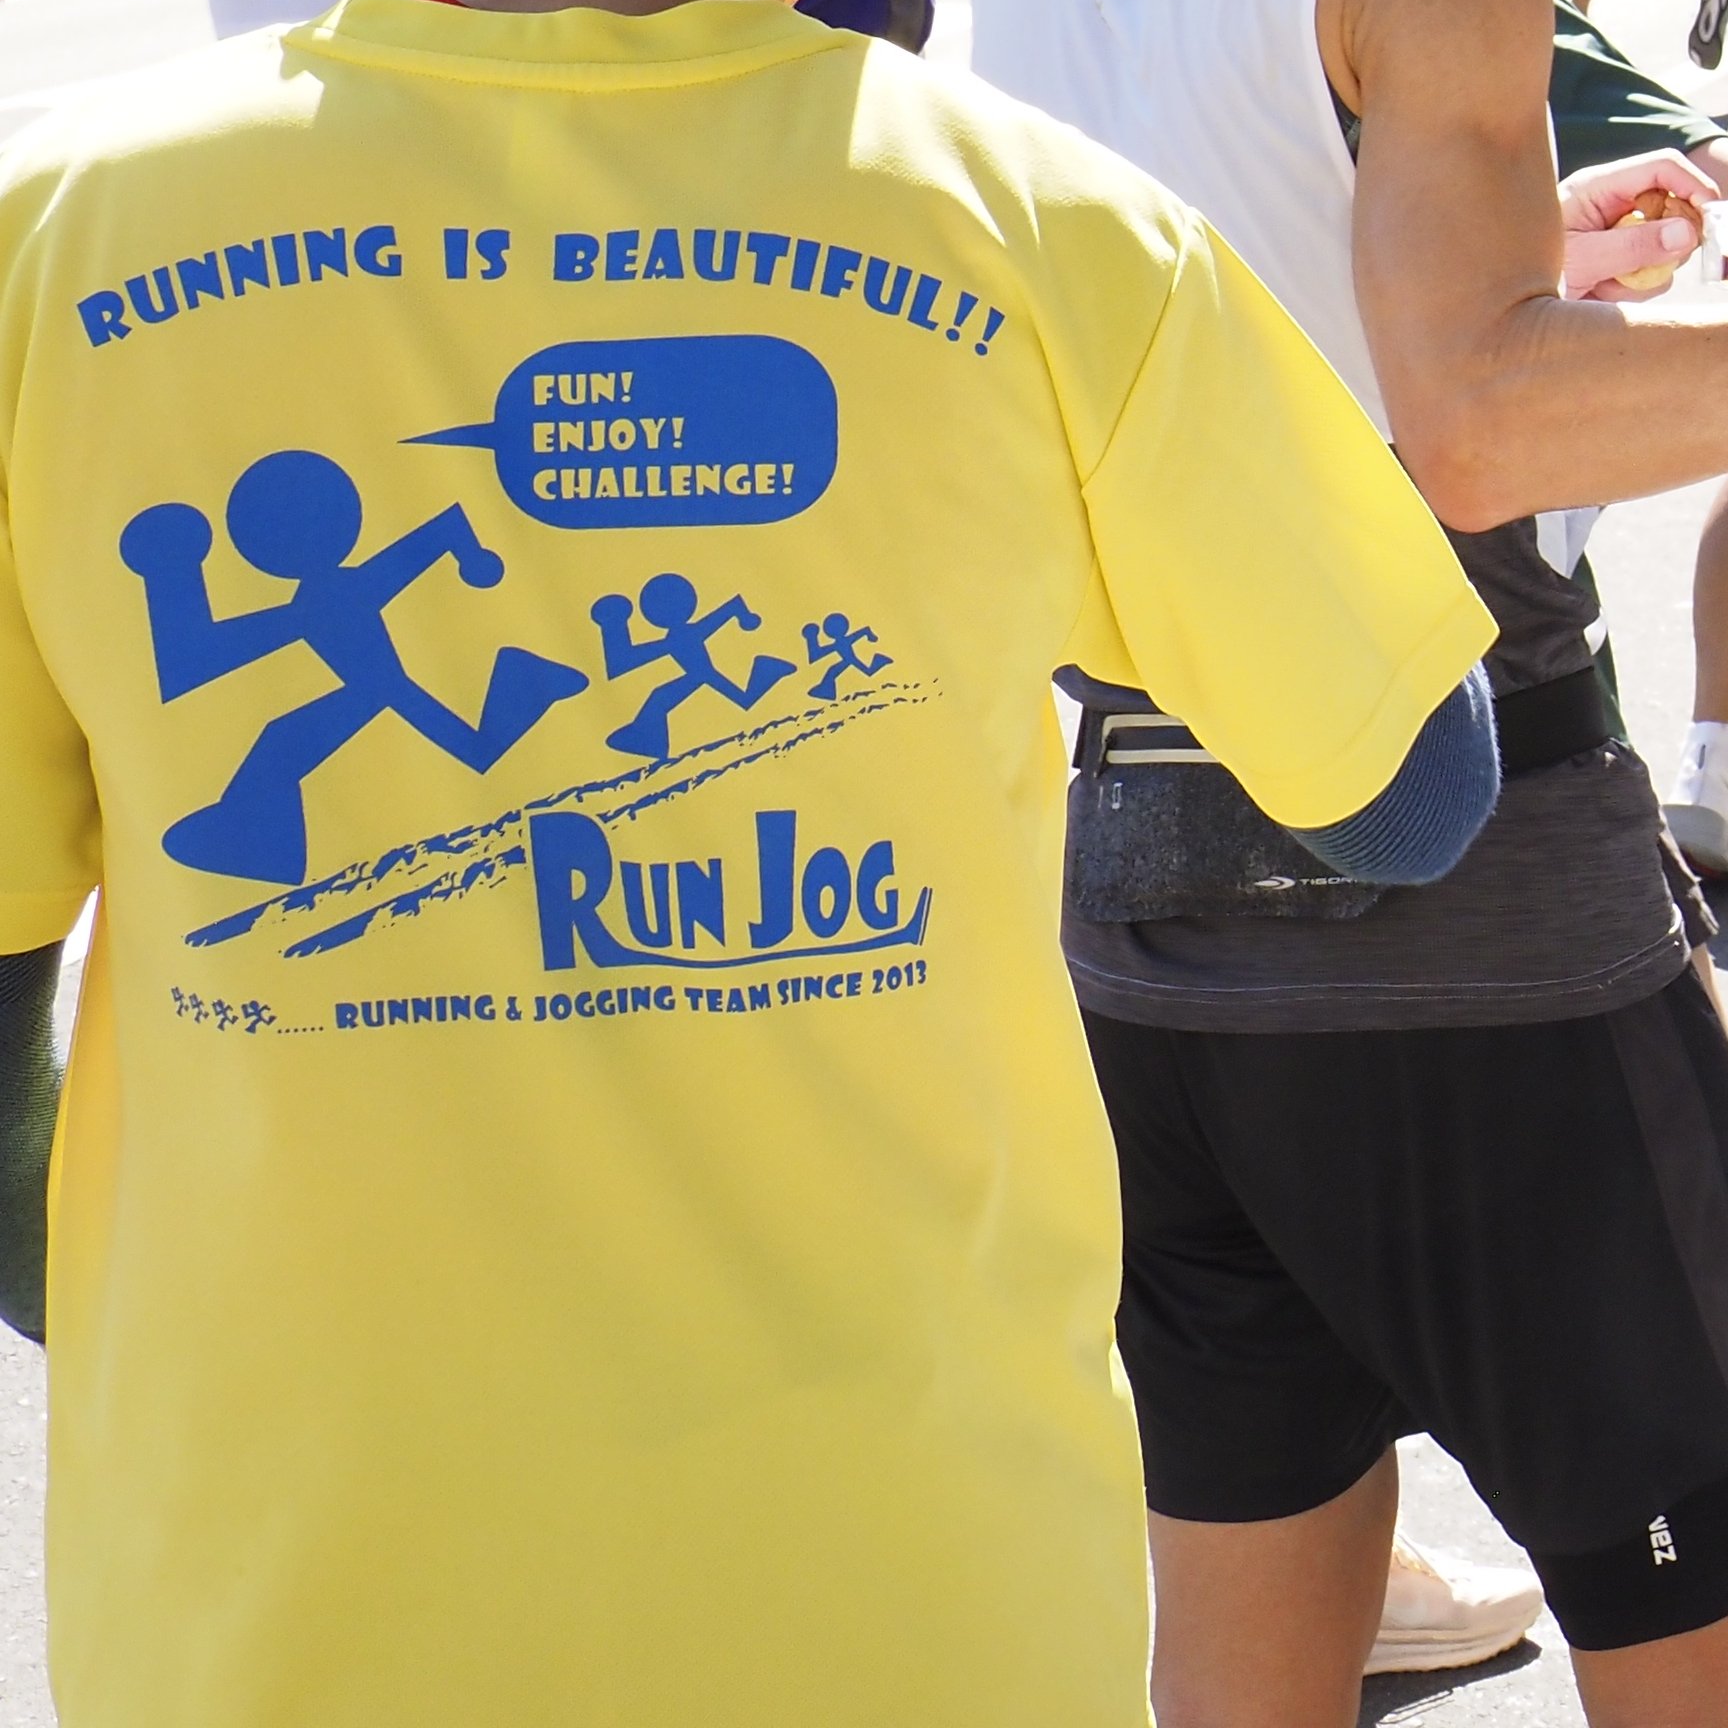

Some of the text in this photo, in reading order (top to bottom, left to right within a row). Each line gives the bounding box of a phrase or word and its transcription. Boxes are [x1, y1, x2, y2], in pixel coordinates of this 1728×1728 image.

[78, 225, 1004, 357] RUNNING IS BEAUTIFUL!!
[534, 373, 632, 405] FUN!
[534, 418, 683, 452] ENJOY!
[534, 464, 794, 500] CHALLENGE!
[336, 960, 927, 1029] RUNNING & JOGGING TEAM SINCE 2013
